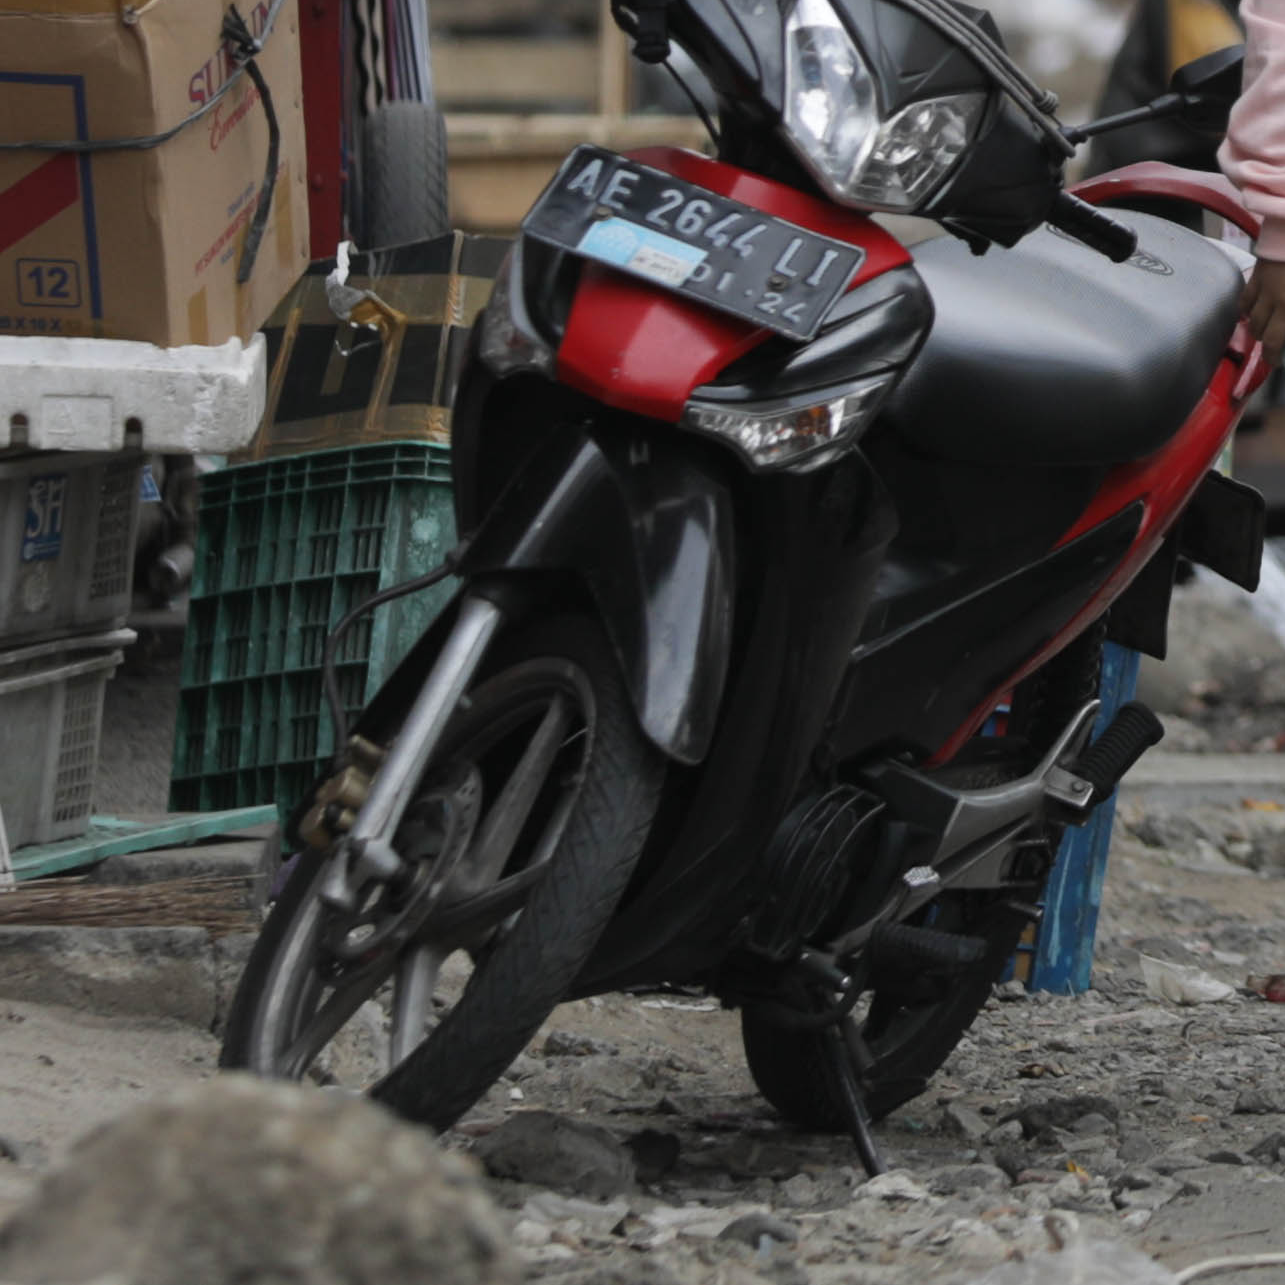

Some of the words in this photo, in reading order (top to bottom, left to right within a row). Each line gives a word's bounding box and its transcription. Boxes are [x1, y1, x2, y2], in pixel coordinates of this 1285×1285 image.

[568, 159, 640, 211] AE
[645, 189, 768, 258] 2644
[774, 238, 840, 288] LI
[28, 267, 70, 299] 12
